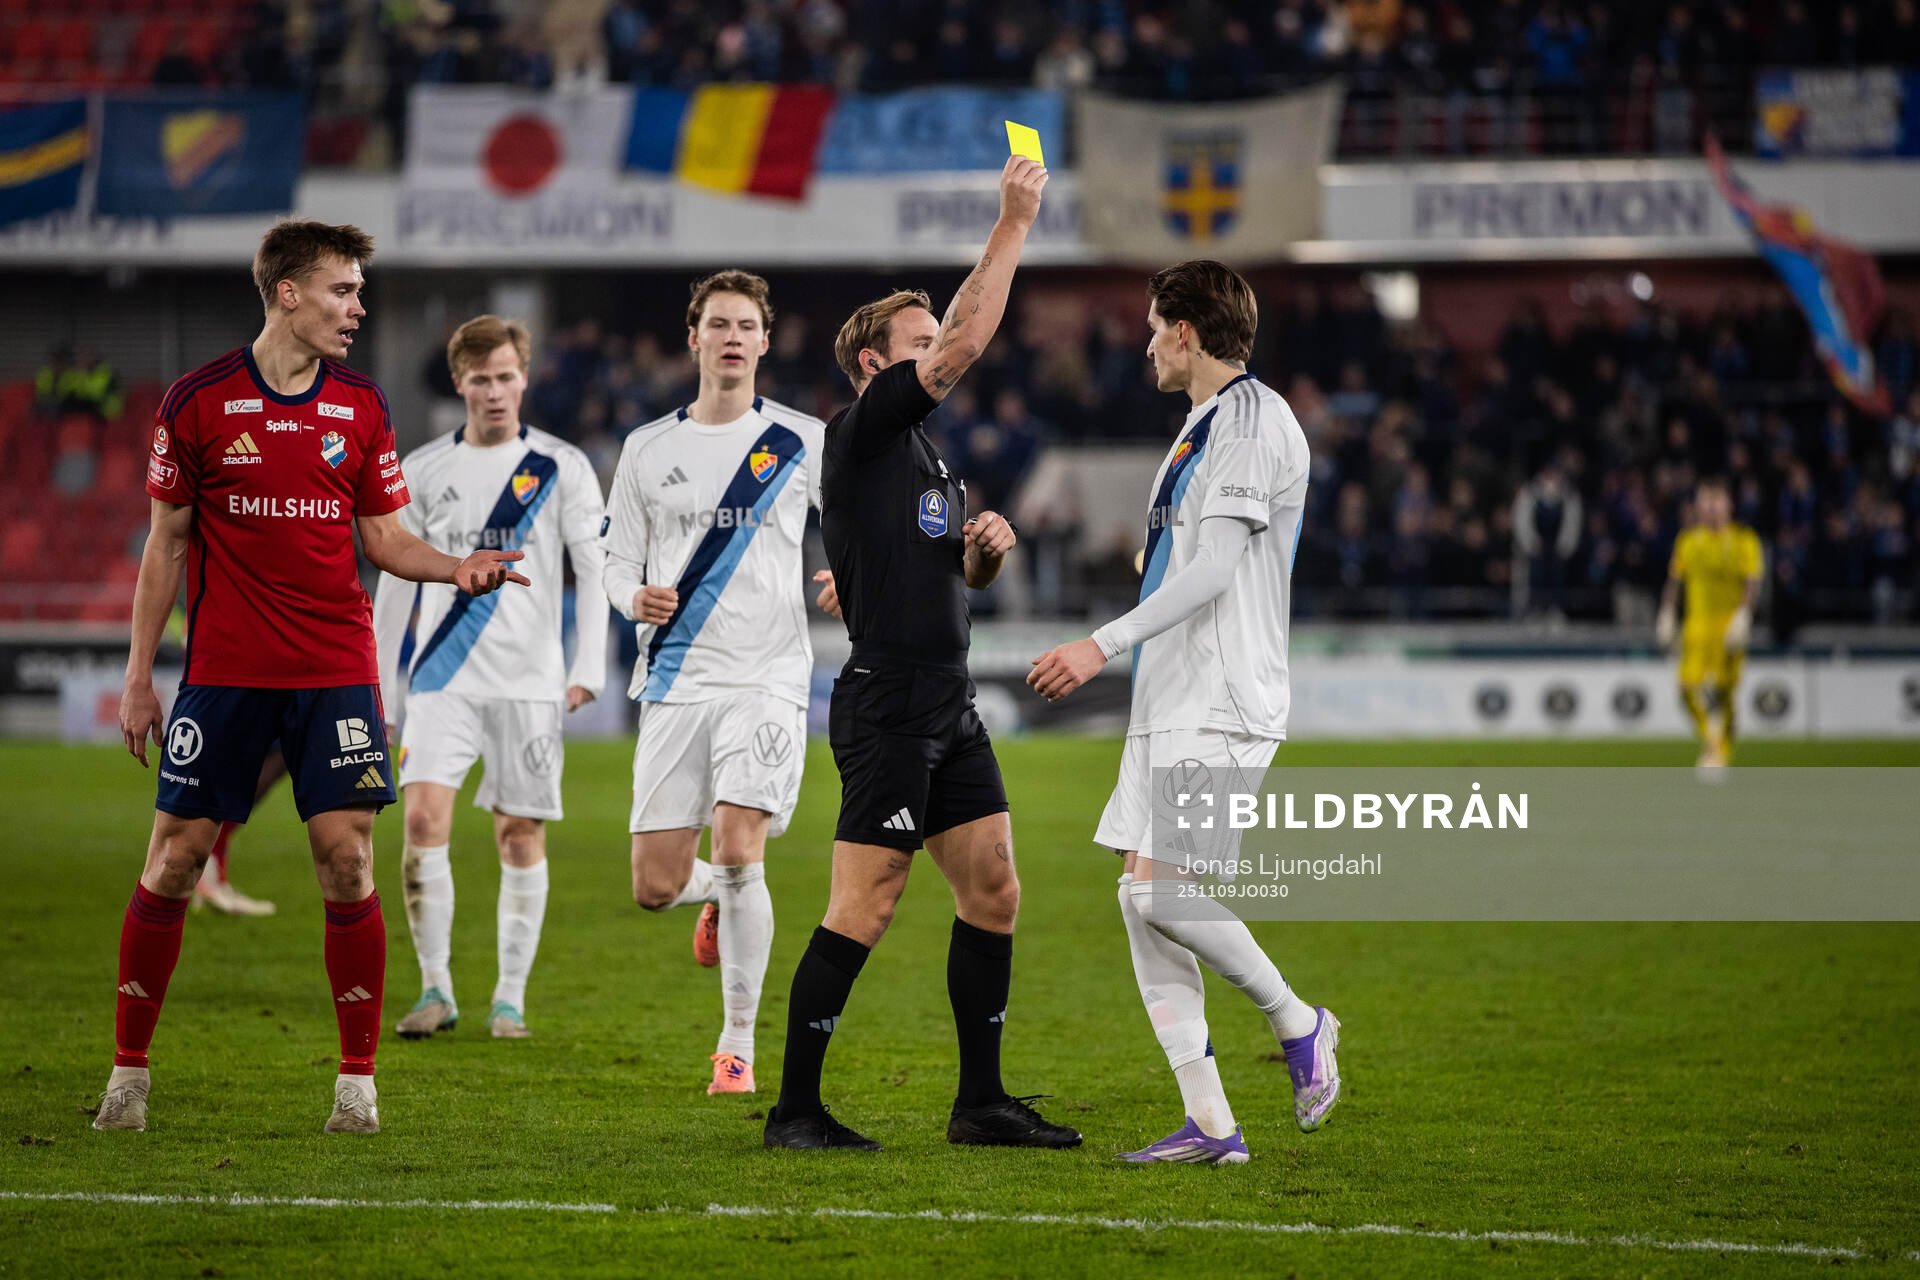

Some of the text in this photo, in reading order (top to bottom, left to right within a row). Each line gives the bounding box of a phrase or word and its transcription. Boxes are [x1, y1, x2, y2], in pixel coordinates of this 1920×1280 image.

[1412, 182, 1708, 239] PREMON
[266, 420, 298, 433] Spiris
[222, 456, 262, 465] stadium
[228, 494, 341, 519] EMILSHUS
[678, 507, 774, 538] MOBILL
[330, 751, 384, 769] BALCO
[188, 777, 200, 786] Bil
